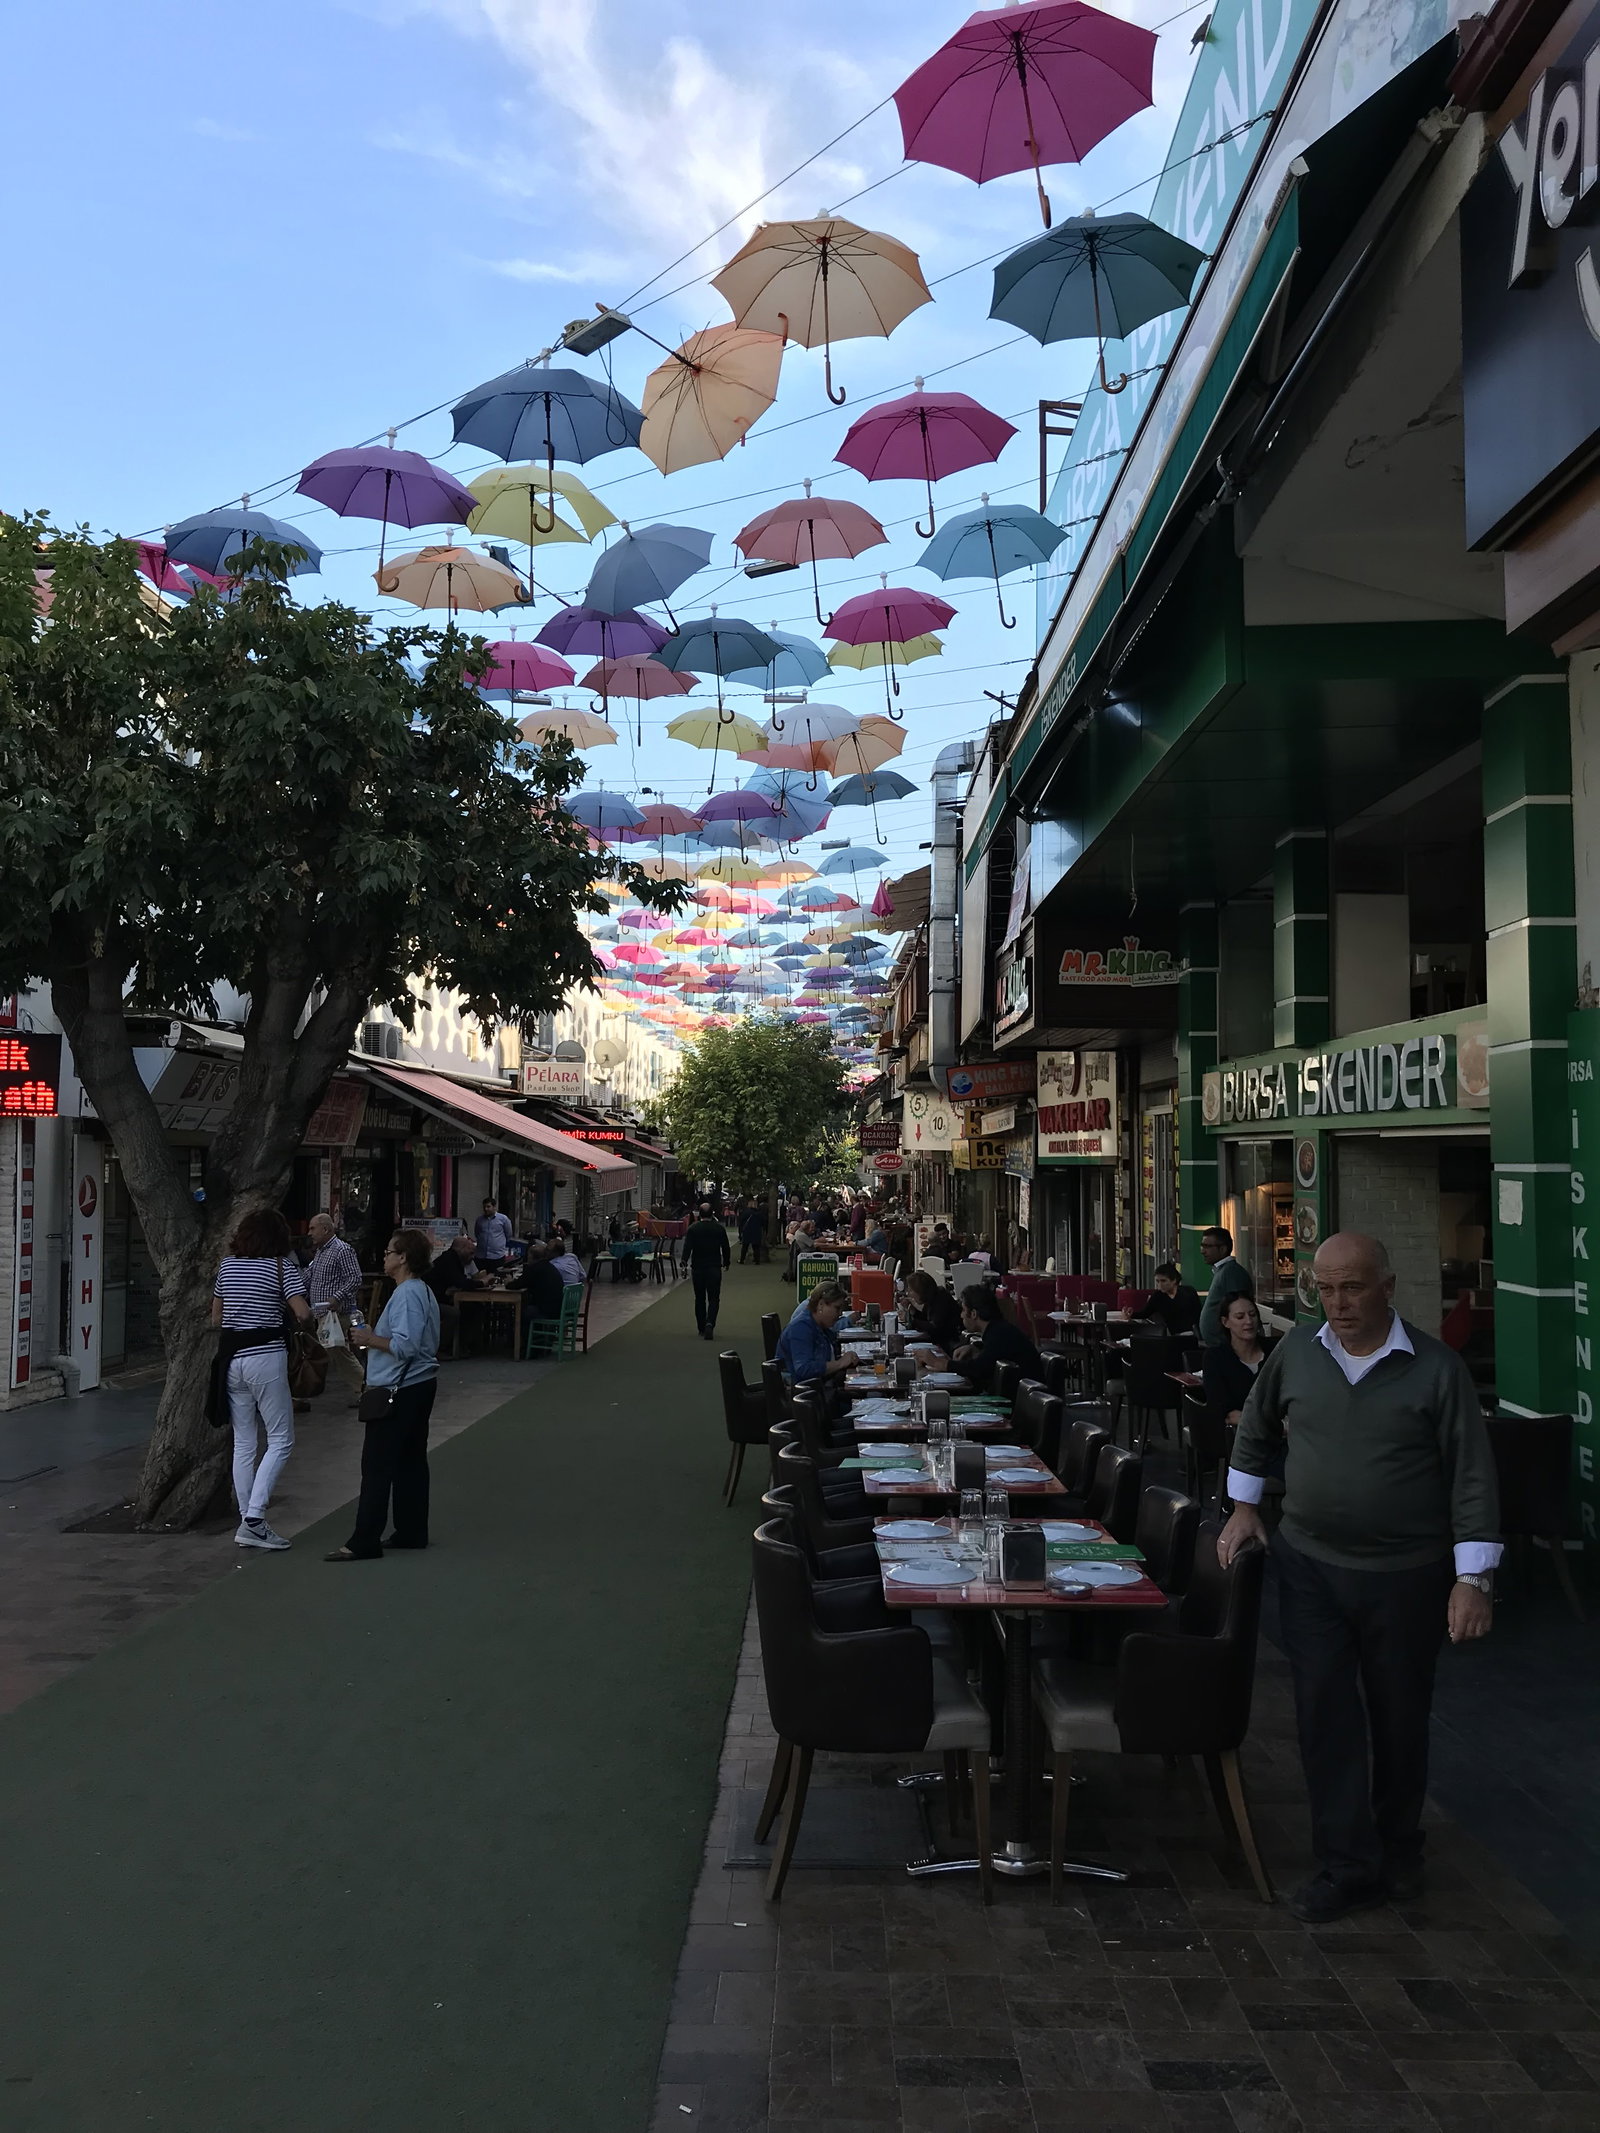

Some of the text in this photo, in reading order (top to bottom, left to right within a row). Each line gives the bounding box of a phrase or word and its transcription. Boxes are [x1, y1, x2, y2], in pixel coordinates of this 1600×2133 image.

[181, 1061, 241, 1102] BTS
[974, 1067, 1007, 1084] KING
[1222, 1034, 1448, 1122] BURSA İSKENDER
[0, 1080, 56, 1111] ath
[1040, 1098, 1111, 1134] VAKIFLAR
[588, 1131, 624, 1141] KUMRU
[80, 1233, 93, 1350] THY
